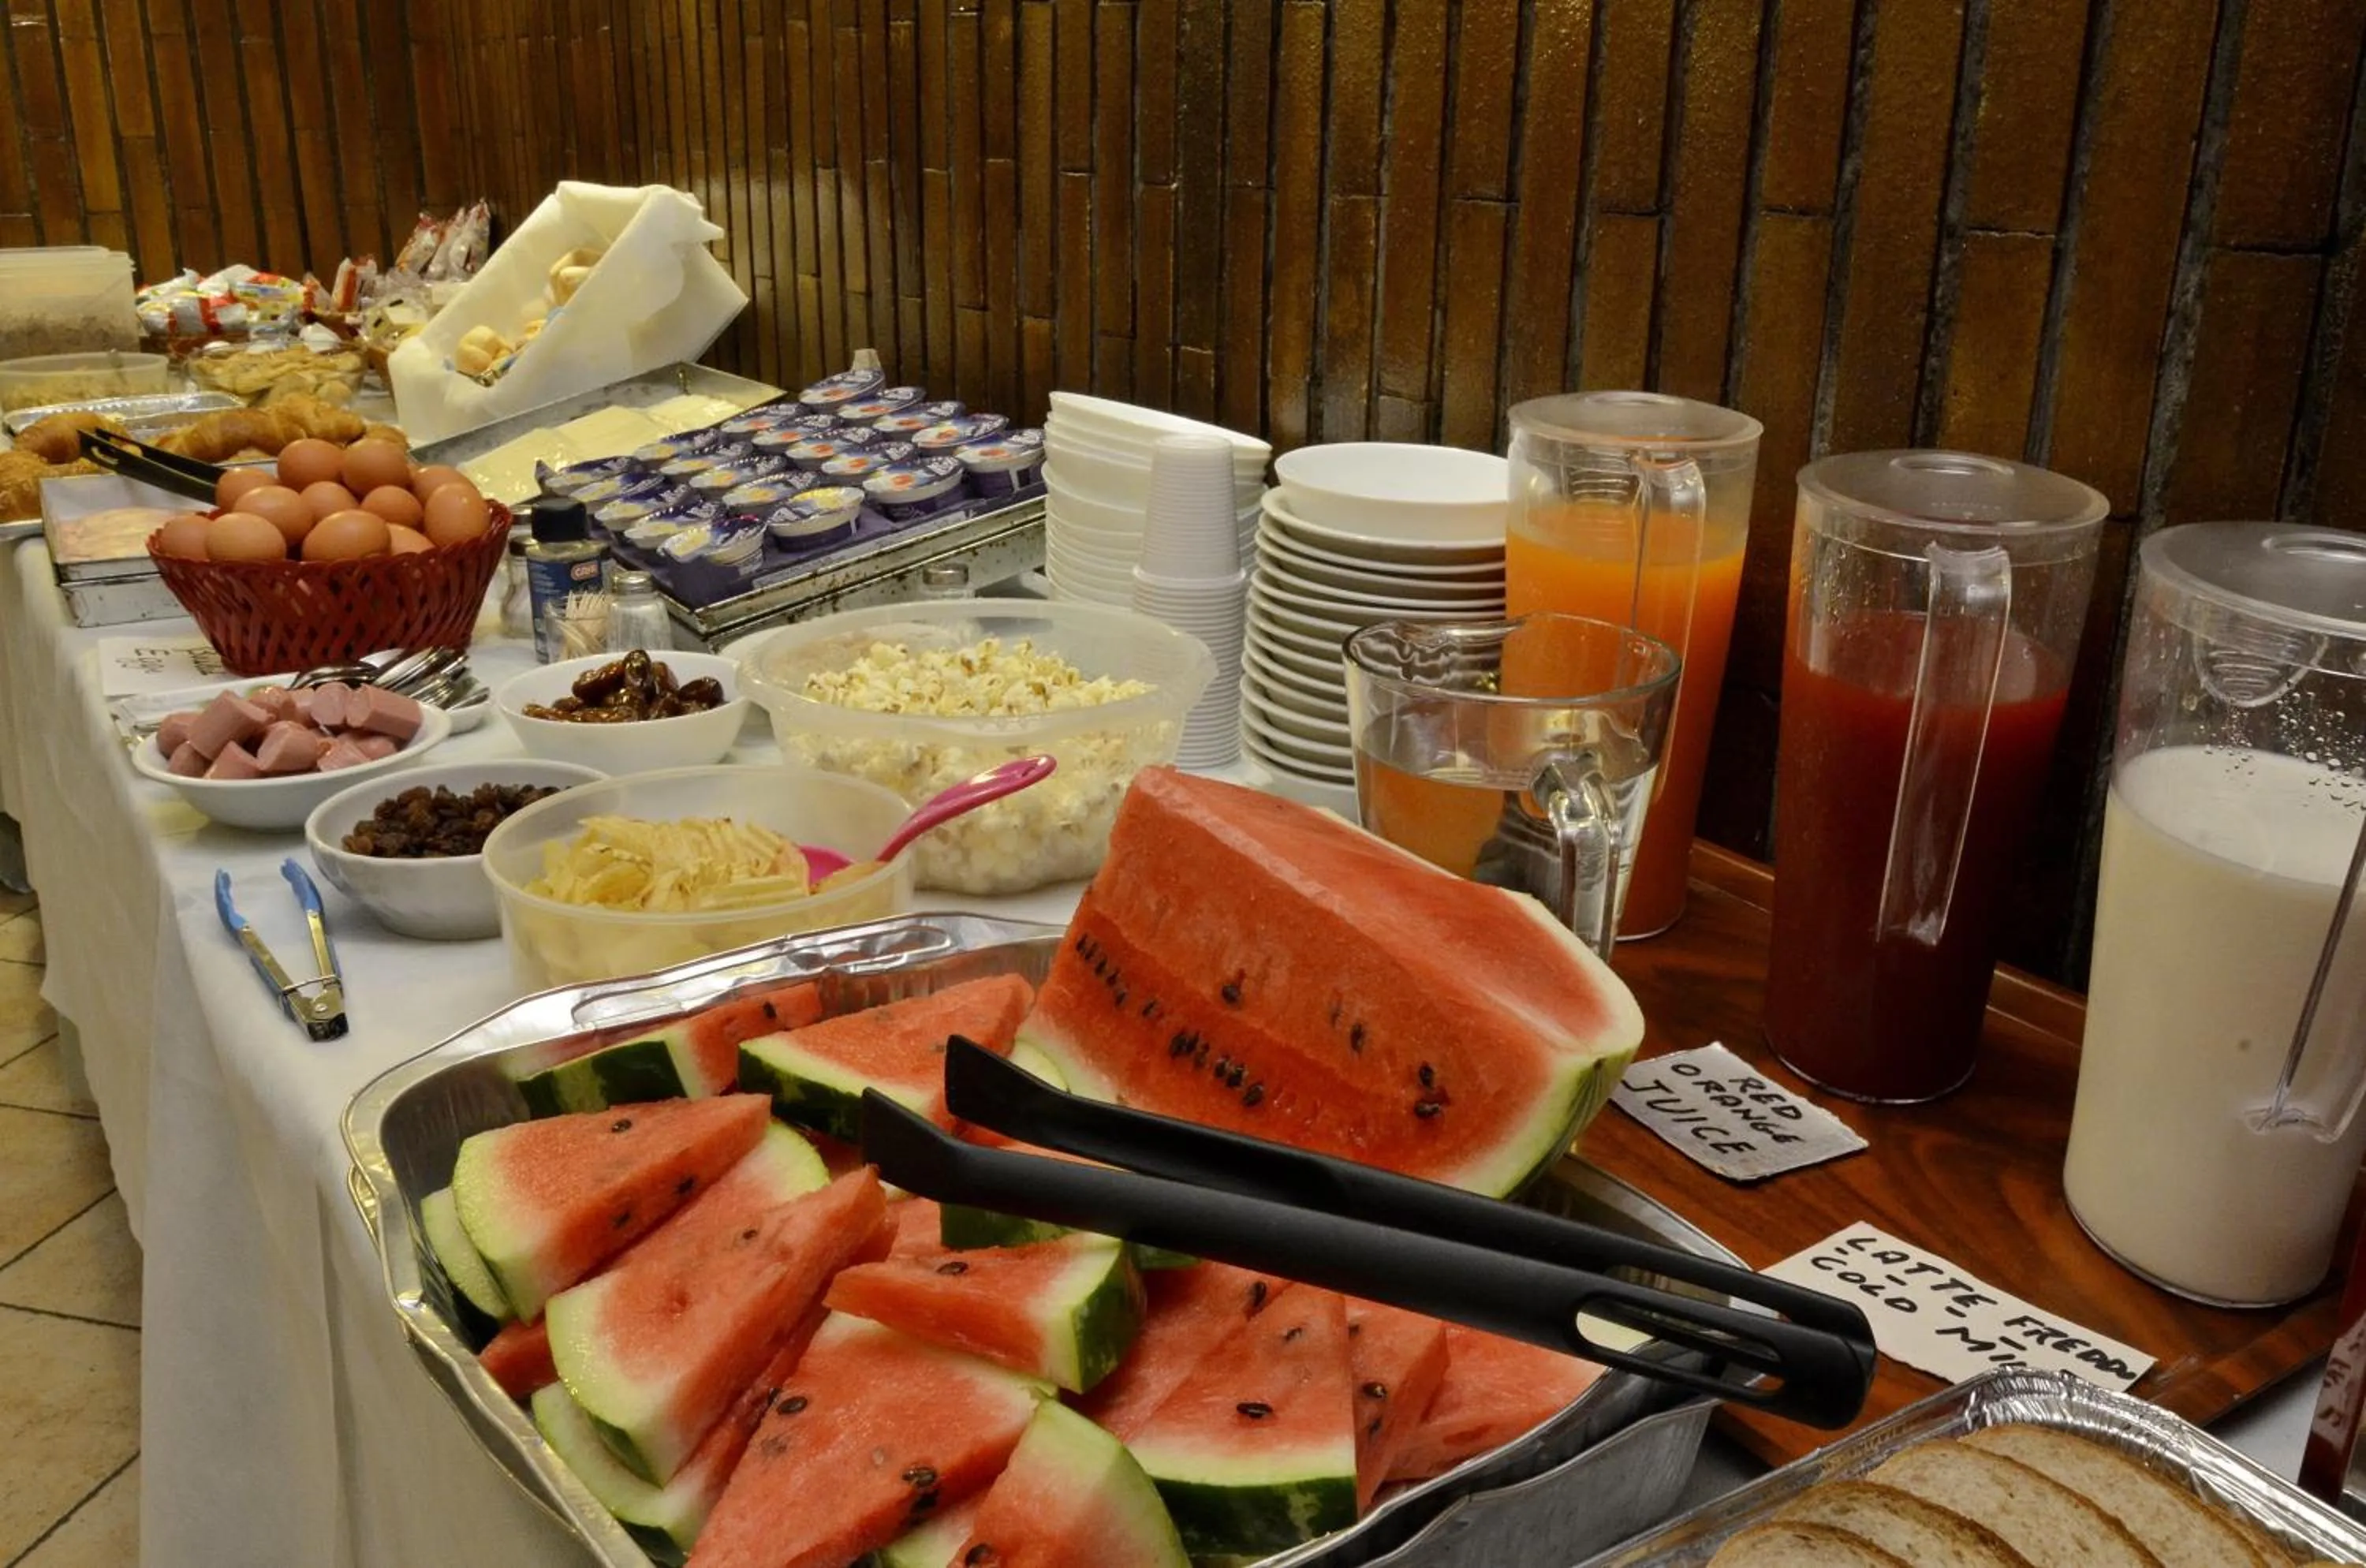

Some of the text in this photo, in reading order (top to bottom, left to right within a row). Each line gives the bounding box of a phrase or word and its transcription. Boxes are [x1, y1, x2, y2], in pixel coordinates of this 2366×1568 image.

[1621, 1078, 1758, 1155] JUICE
[1670, 1063, 1807, 1144] ORANGE
[1728, 1077, 1804, 1120] RED
[1810, 1256, 1918, 1313] COLD
[1845, 1237, 1998, 1309] LATTE
